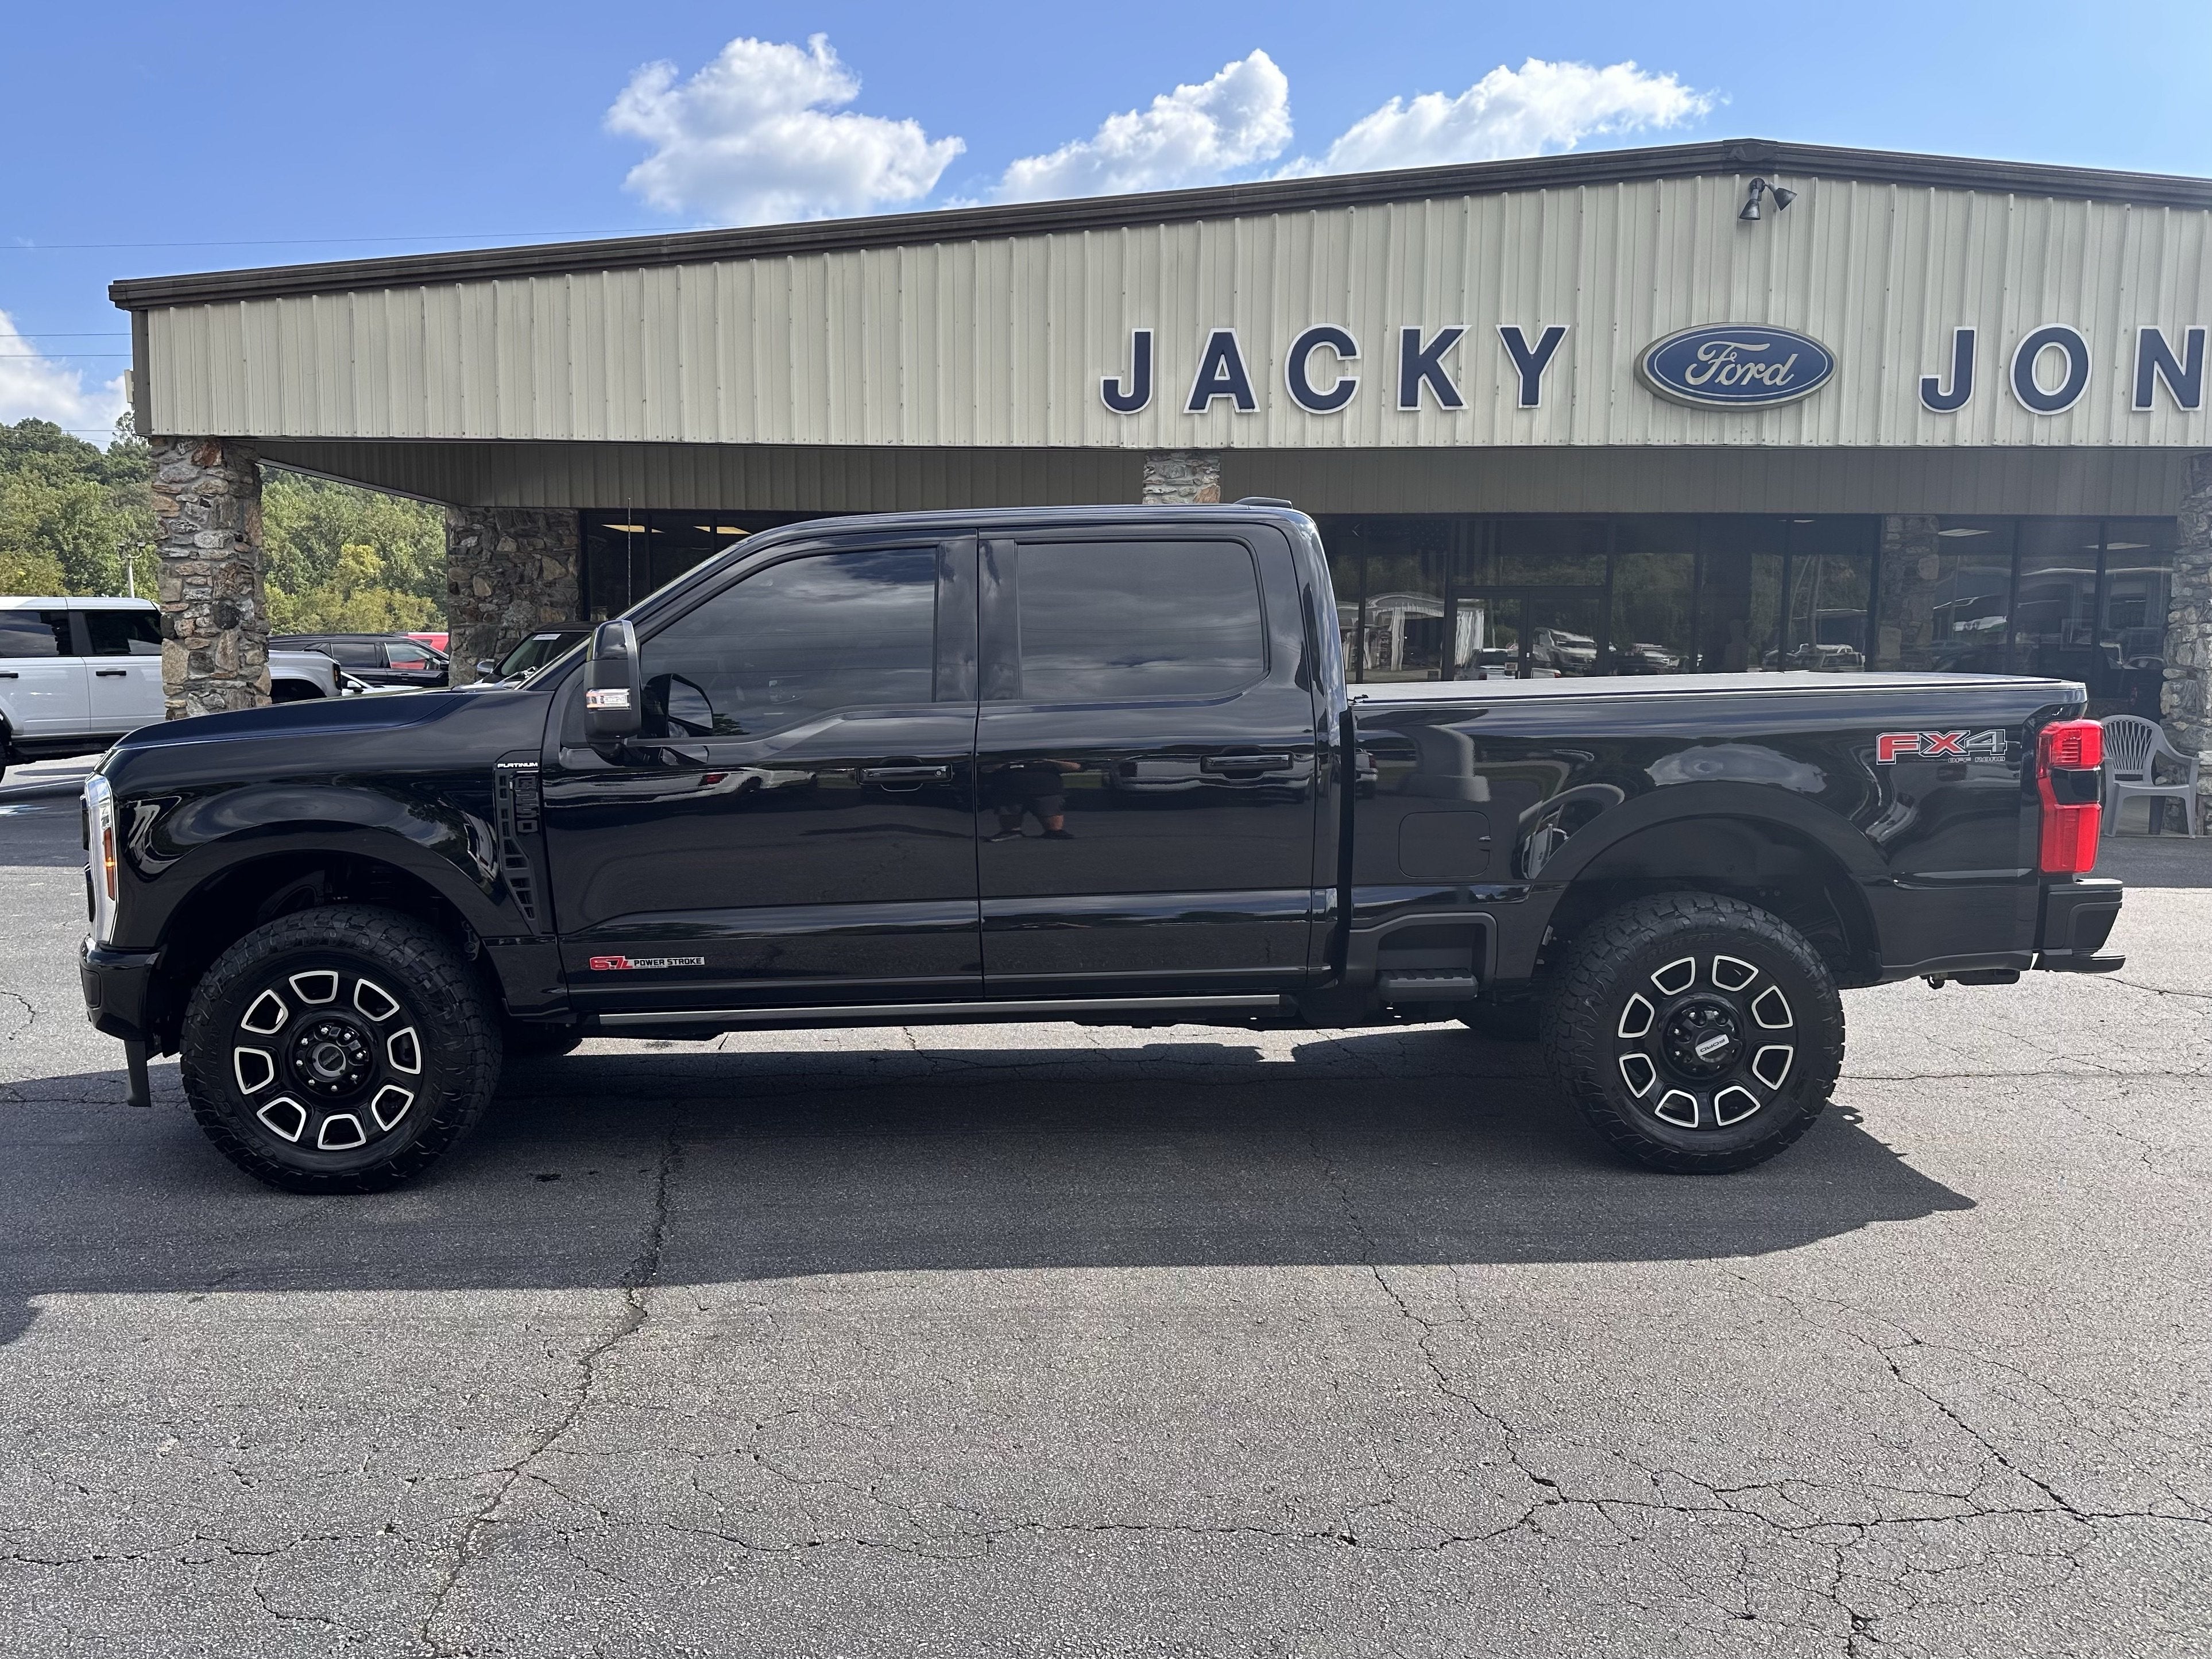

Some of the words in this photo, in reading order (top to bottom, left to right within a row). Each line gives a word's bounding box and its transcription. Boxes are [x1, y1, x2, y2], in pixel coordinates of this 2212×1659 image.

[1100, 323, 1571, 415] JACKY
[1684, 341, 1798, 386] Ford
[1919, 323, 2208, 415] JON
[1876, 729, 2008, 765] FX4
[589, 956, 633, 970] 6.7L
